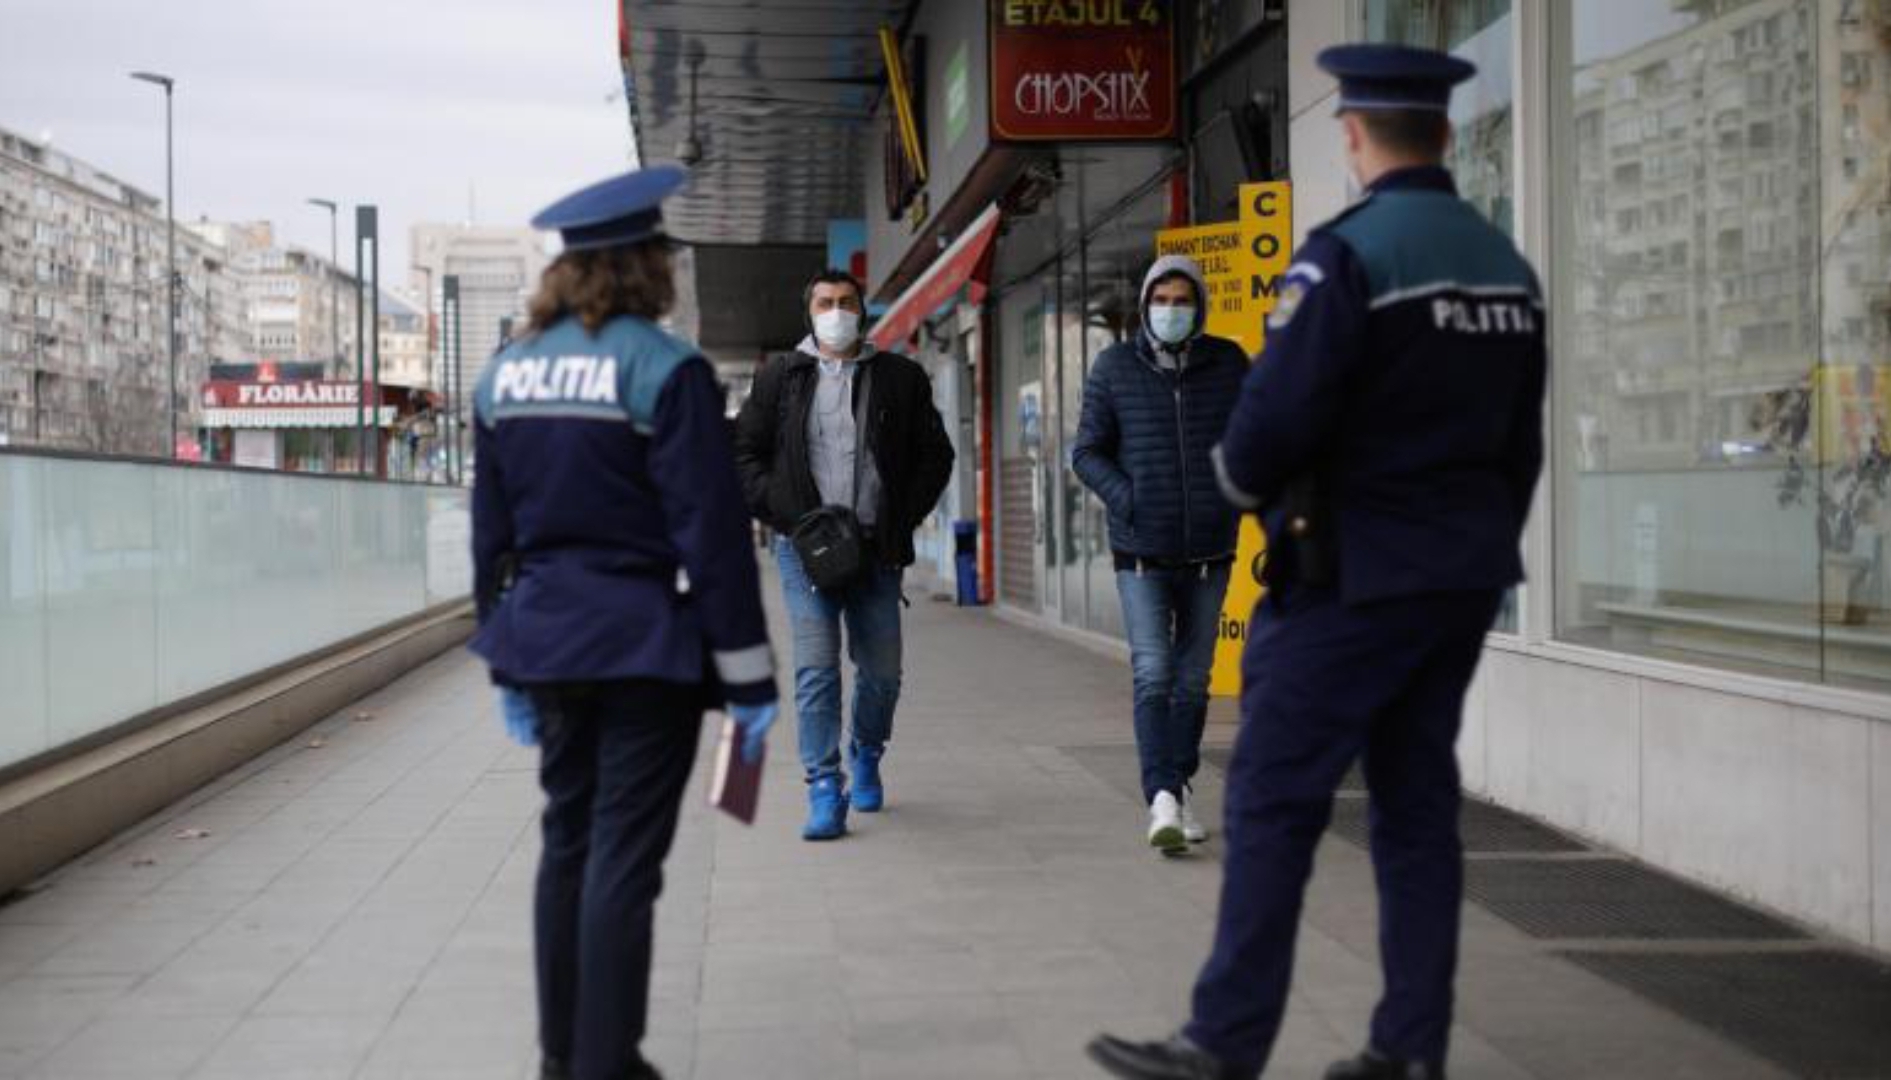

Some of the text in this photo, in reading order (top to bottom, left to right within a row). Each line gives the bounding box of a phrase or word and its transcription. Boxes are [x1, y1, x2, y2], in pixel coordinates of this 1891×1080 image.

[1005, 0, 1160, 26] ETAJUL 4
[1014, 70, 1150, 116] CHOPSTIX
[493, 356, 617, 403] POLITIA
